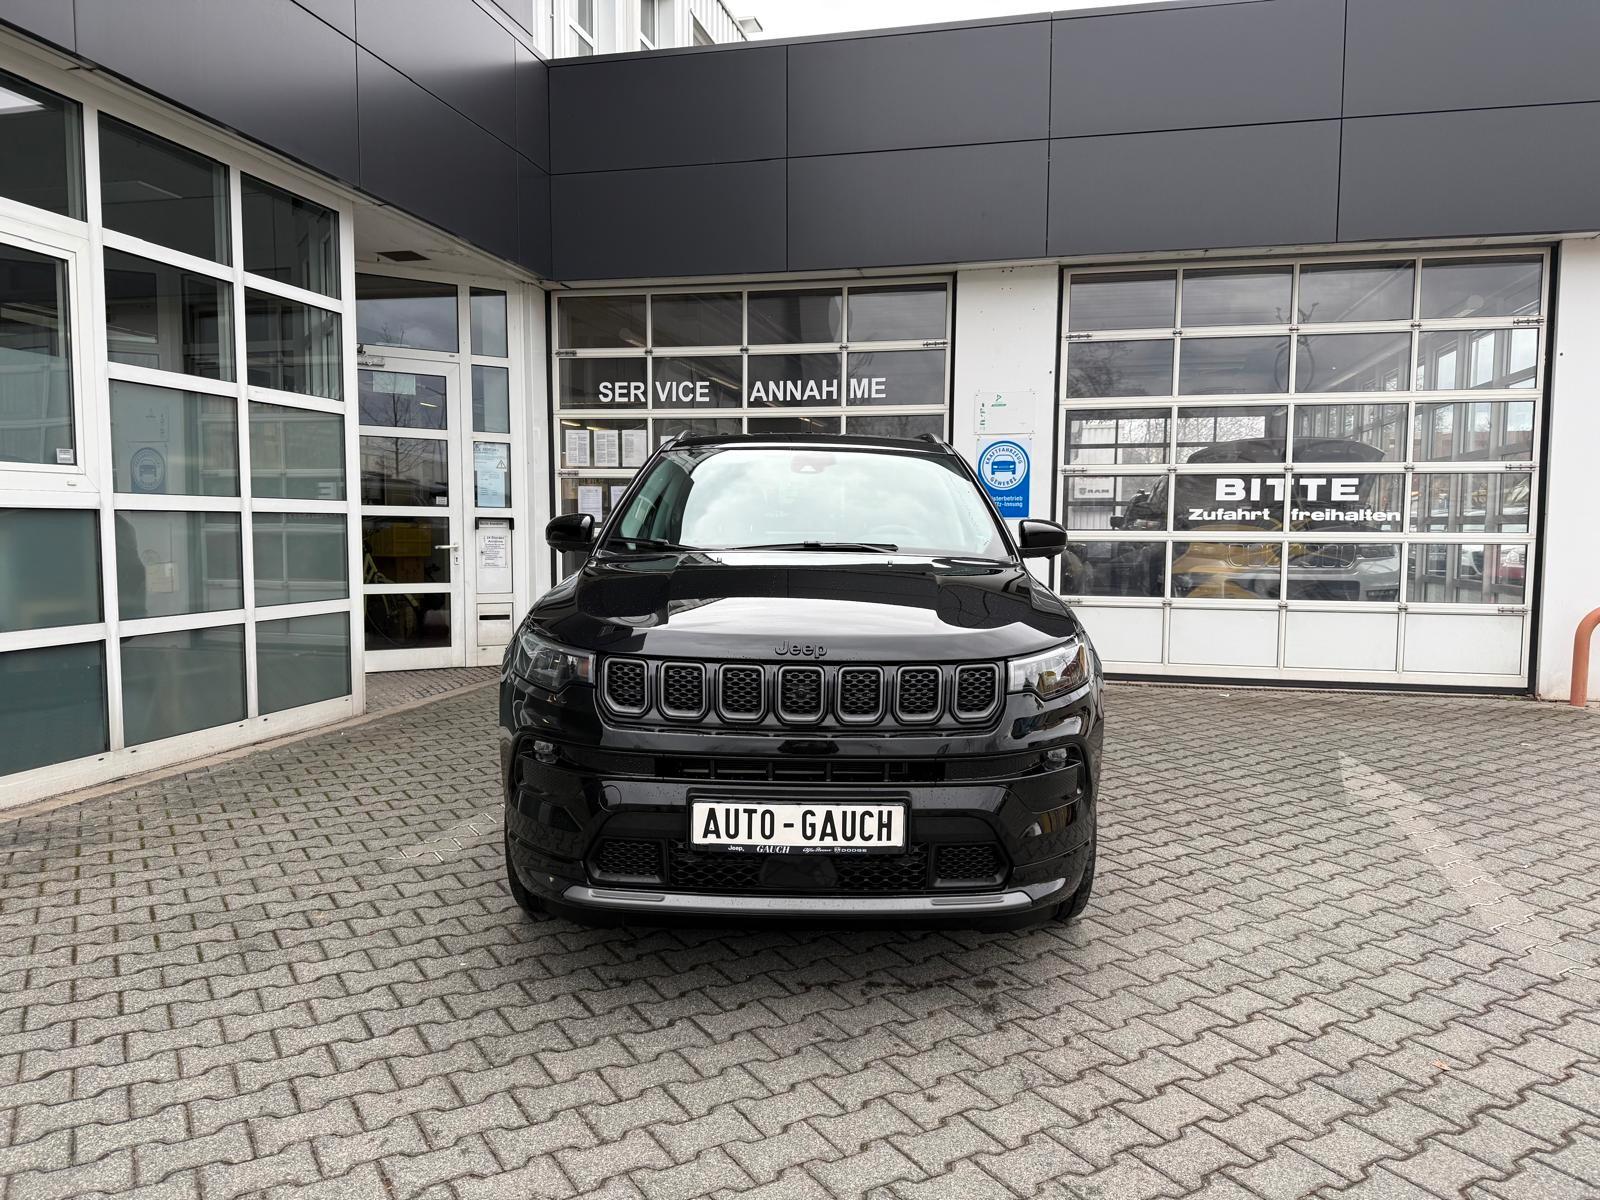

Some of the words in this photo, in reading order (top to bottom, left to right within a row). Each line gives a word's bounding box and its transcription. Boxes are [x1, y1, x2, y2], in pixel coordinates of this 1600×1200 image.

[598, 381, 710, 402] SERVICE
[750, 378, 887, 401] ANNAHME
[985, 447, 1023, 465] KRAFTFAHRZEUG
[990, 477, 1017, 487] GEWERBE
[1216, 478, 1360, 501] BITTE
[1188, 508, 1270, 521] Zufahrt
[1291, 508, 1400, 522] freihalten
[775, 640, 828, 659] Jeep
[702, 807, 775, 840] AUTO
[801, 810, 893, 842] GAUCH
[756, 845, 790, 854] GAUCH
